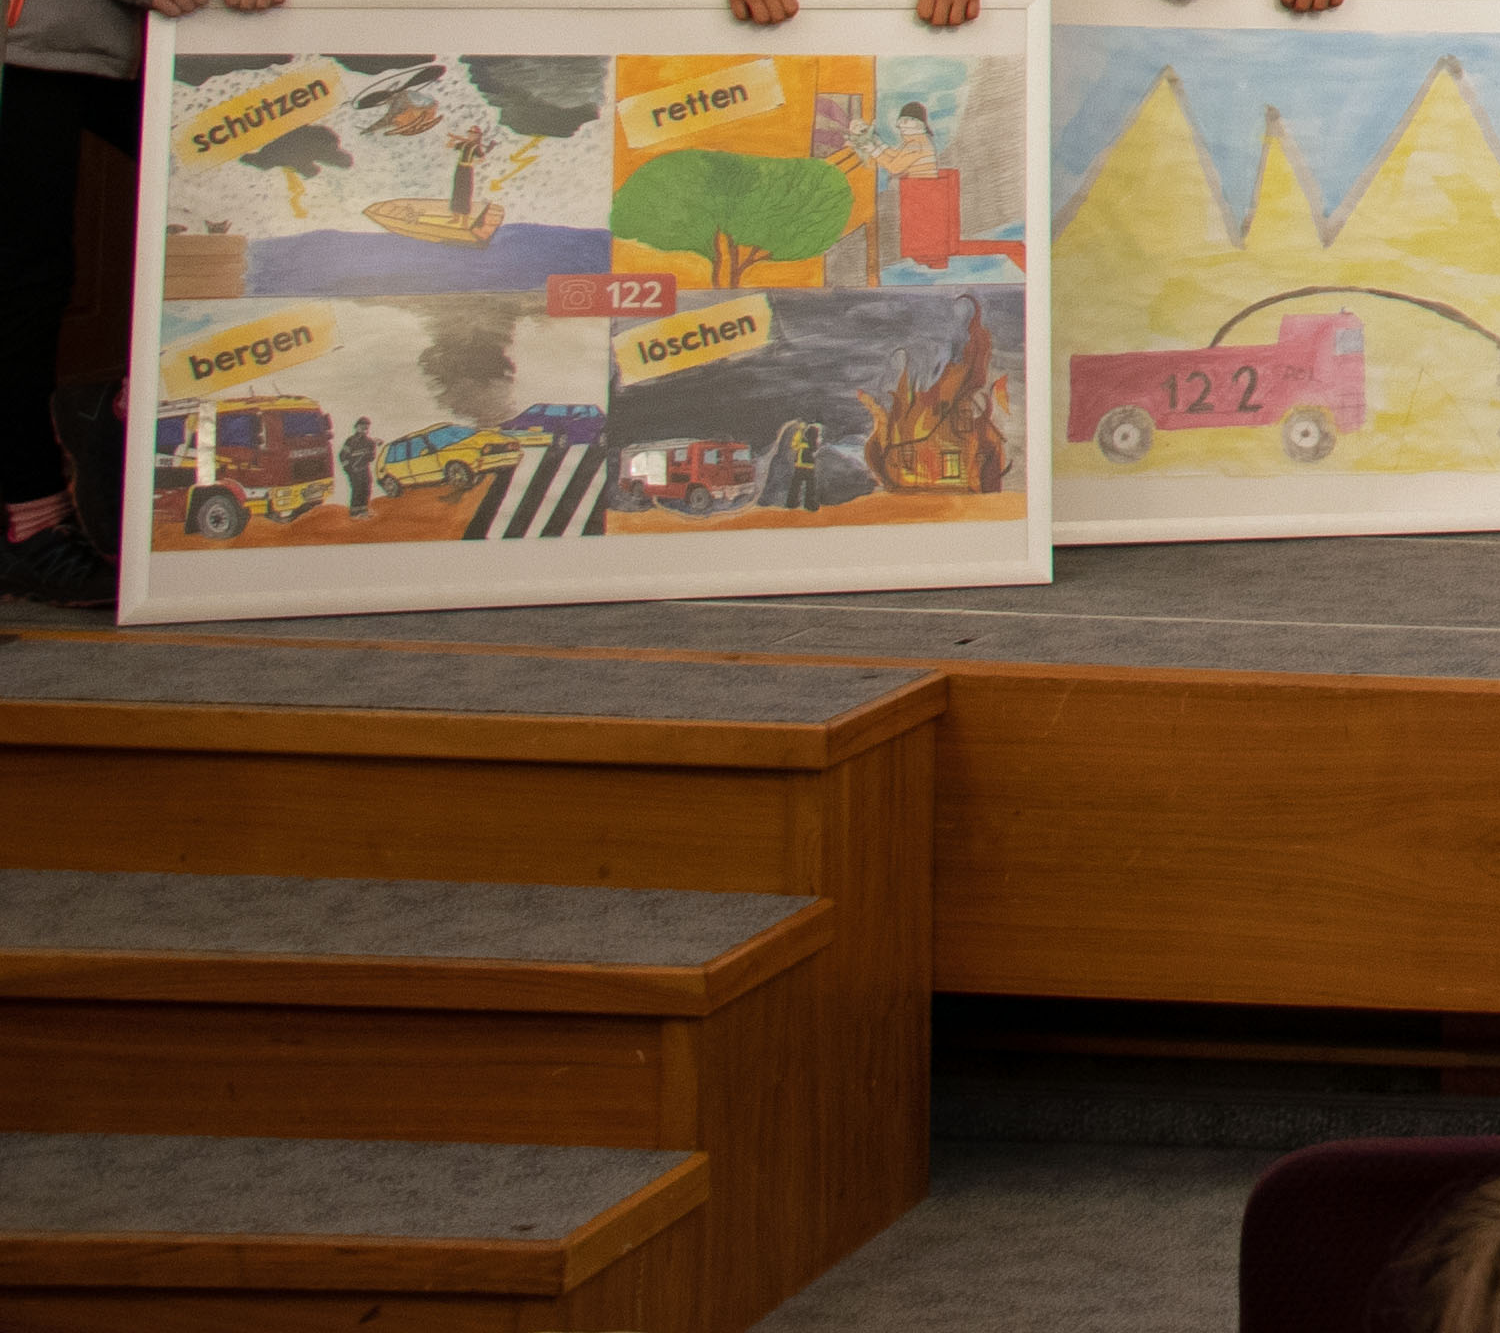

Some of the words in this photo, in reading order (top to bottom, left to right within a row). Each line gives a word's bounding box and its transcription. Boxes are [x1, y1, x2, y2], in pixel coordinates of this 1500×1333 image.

[193, 79, 330, 153] schützen
[652, 84, 748, 127] retten
[606, 281, 662, 309] 122
[188, 325, 313, 380] bergen
[638, 314, 757, 364] löschen
